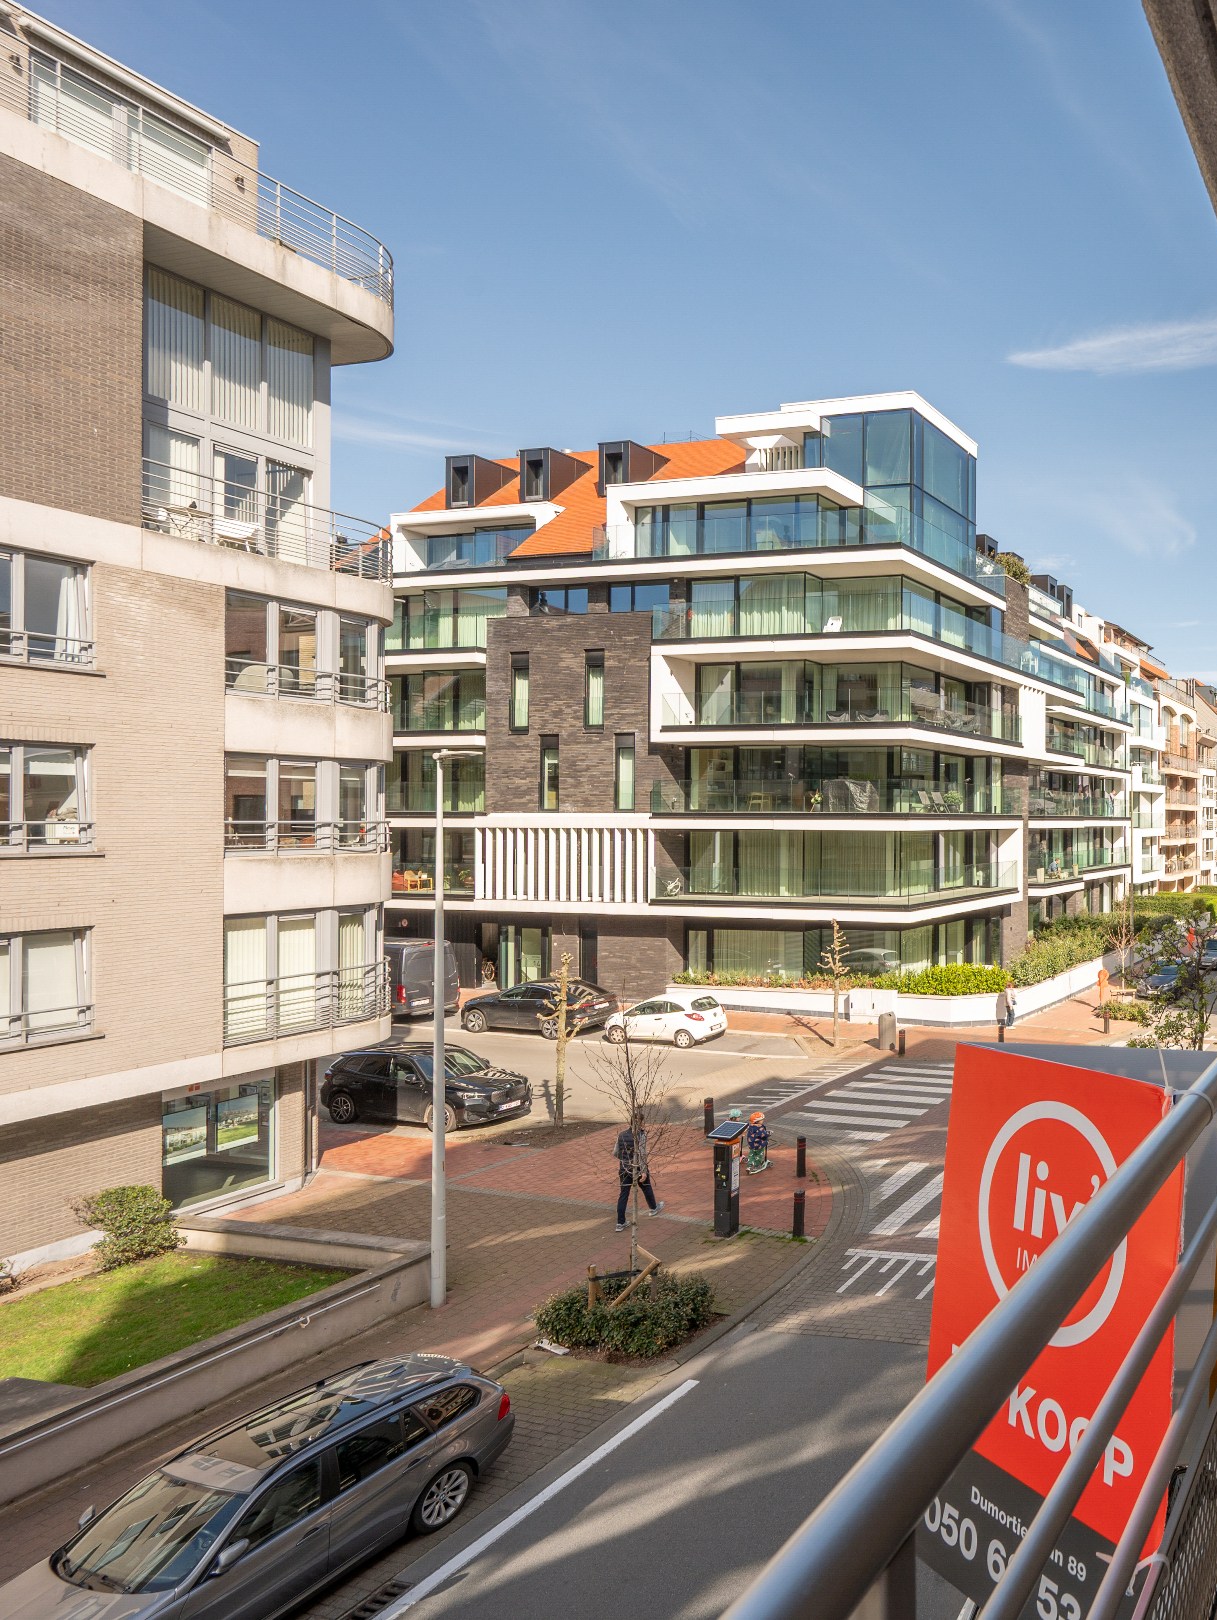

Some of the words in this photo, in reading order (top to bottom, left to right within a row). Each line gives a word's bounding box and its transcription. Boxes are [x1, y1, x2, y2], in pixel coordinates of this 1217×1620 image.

[924, 1496, 978, 1561] 050
[987, 1538, 1017, 1584] 6
[1067, 1555, 1087, 1582] 89
